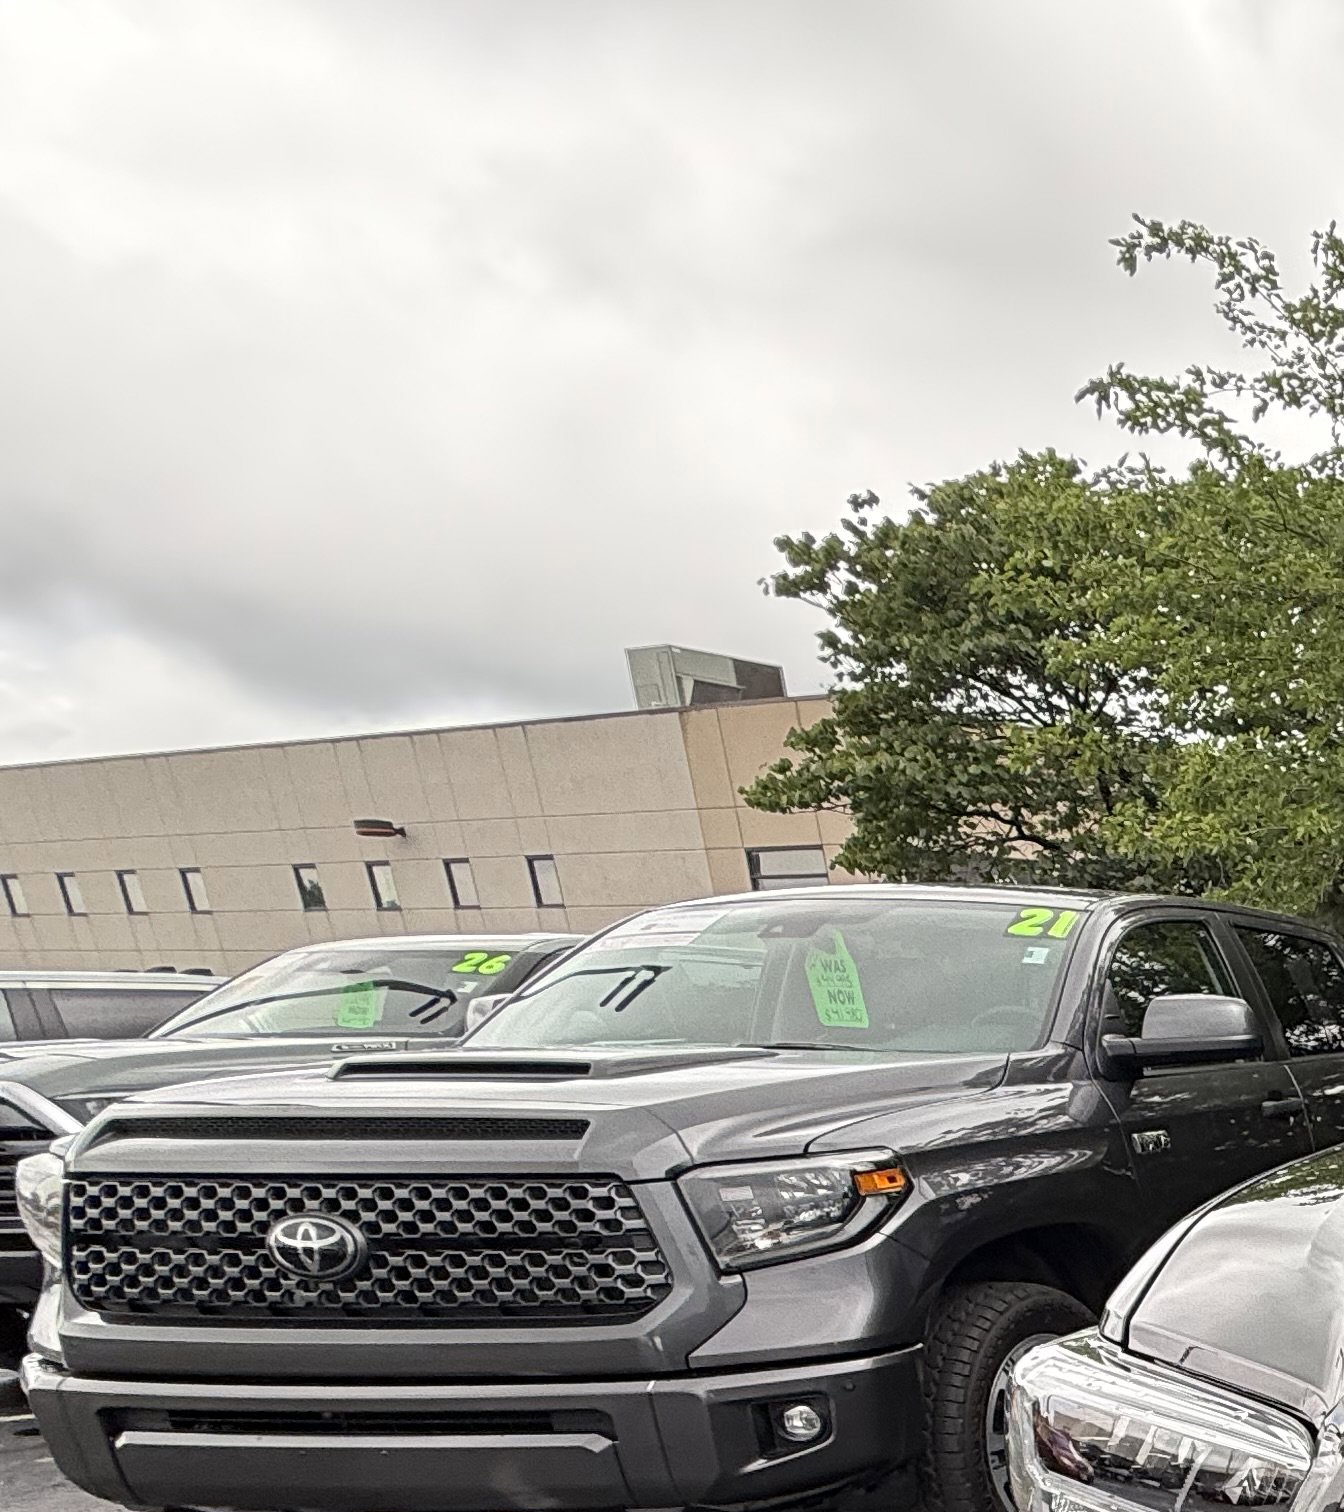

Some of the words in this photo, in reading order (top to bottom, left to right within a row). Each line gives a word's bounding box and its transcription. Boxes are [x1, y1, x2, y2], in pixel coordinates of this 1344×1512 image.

[1008, 908, 1078, 937] 21
[452, 952, 511, 974] 26
[820, 959, 847, 973] WAS
[827, 989, 856, 1005] NOW
